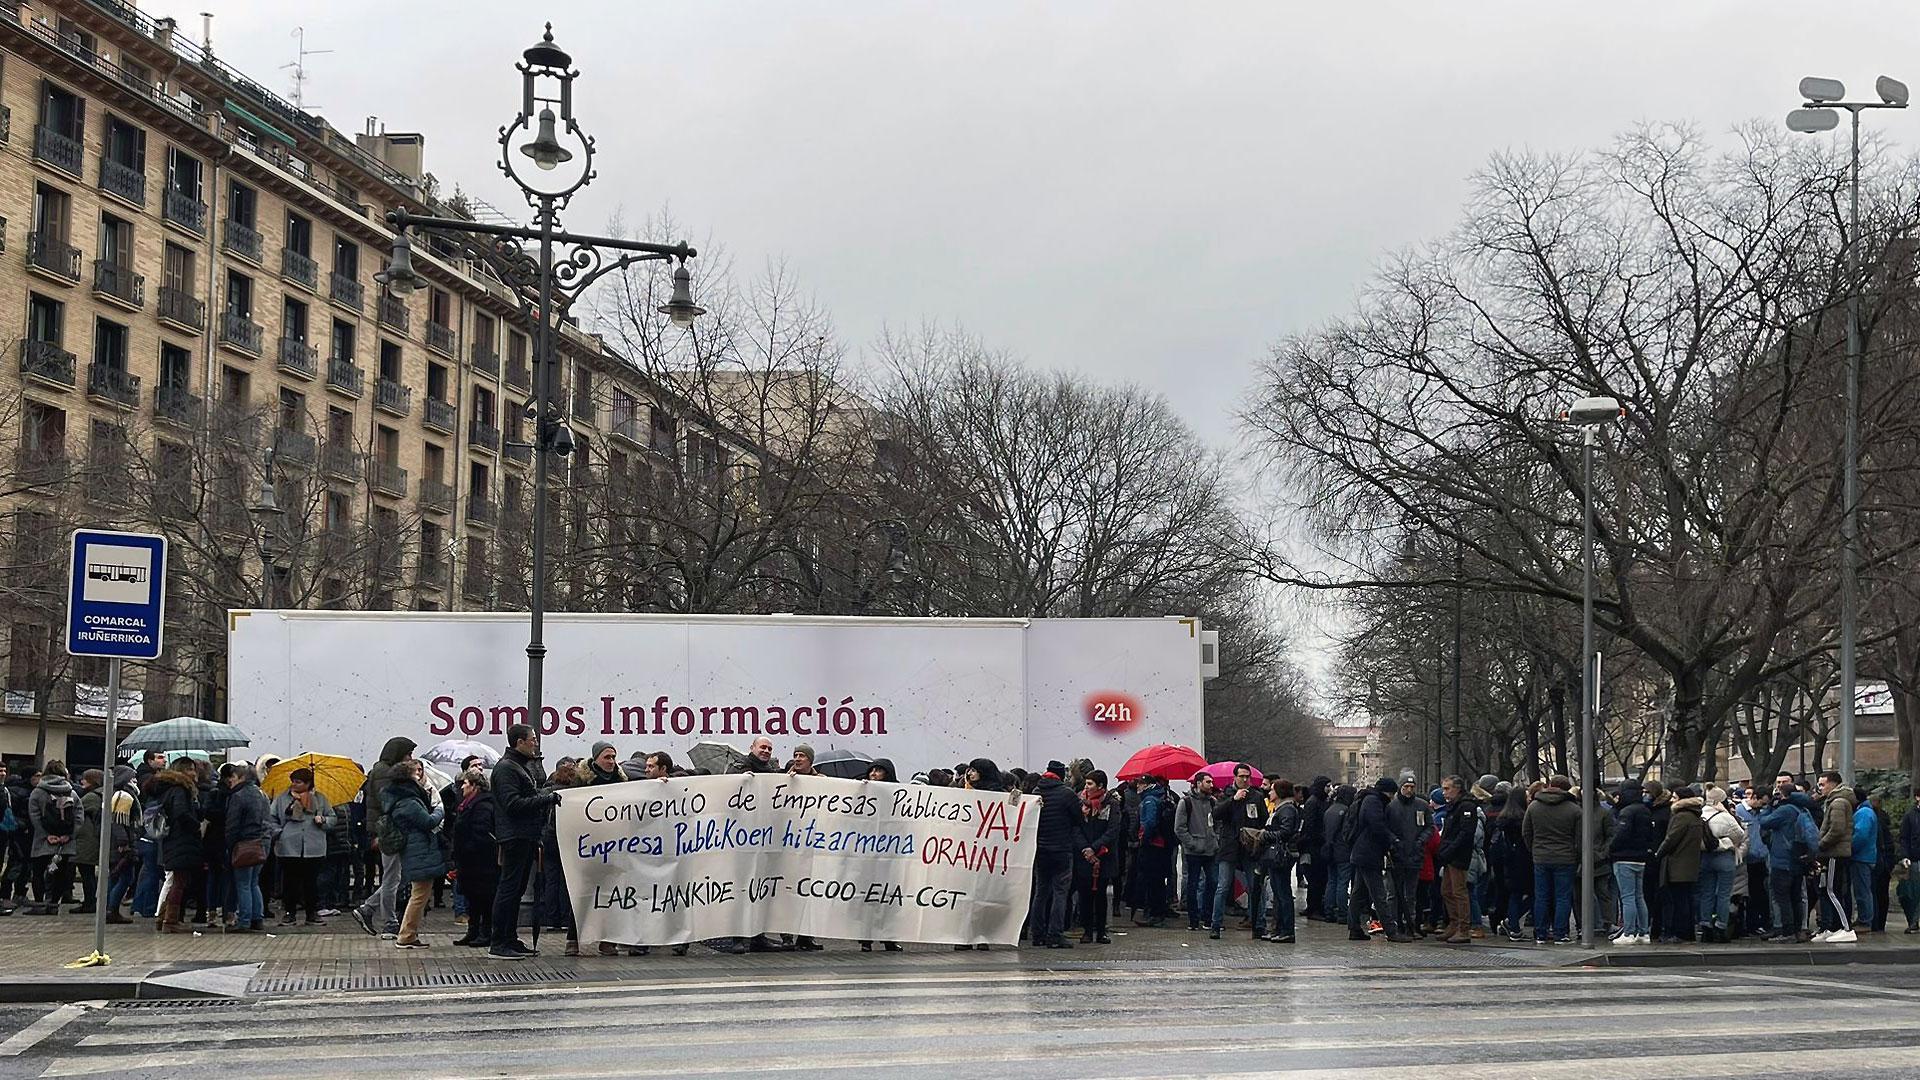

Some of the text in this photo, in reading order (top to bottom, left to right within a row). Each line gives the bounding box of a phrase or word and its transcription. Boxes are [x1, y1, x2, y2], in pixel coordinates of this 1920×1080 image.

[84, 615, 147, 627] COMARCAL
[78, 631, 151, 644] IRUÑERRIKOA
[430, 696, 887, 736] Somos Información
[1094, 703, 1132, 721] 24h
[585, 784, 1026, 843] Convenio de Empresas Públicas YA!
[578, 834, 663, 863] Enpresa
[783, 818, 914, 854] hitzarmena
